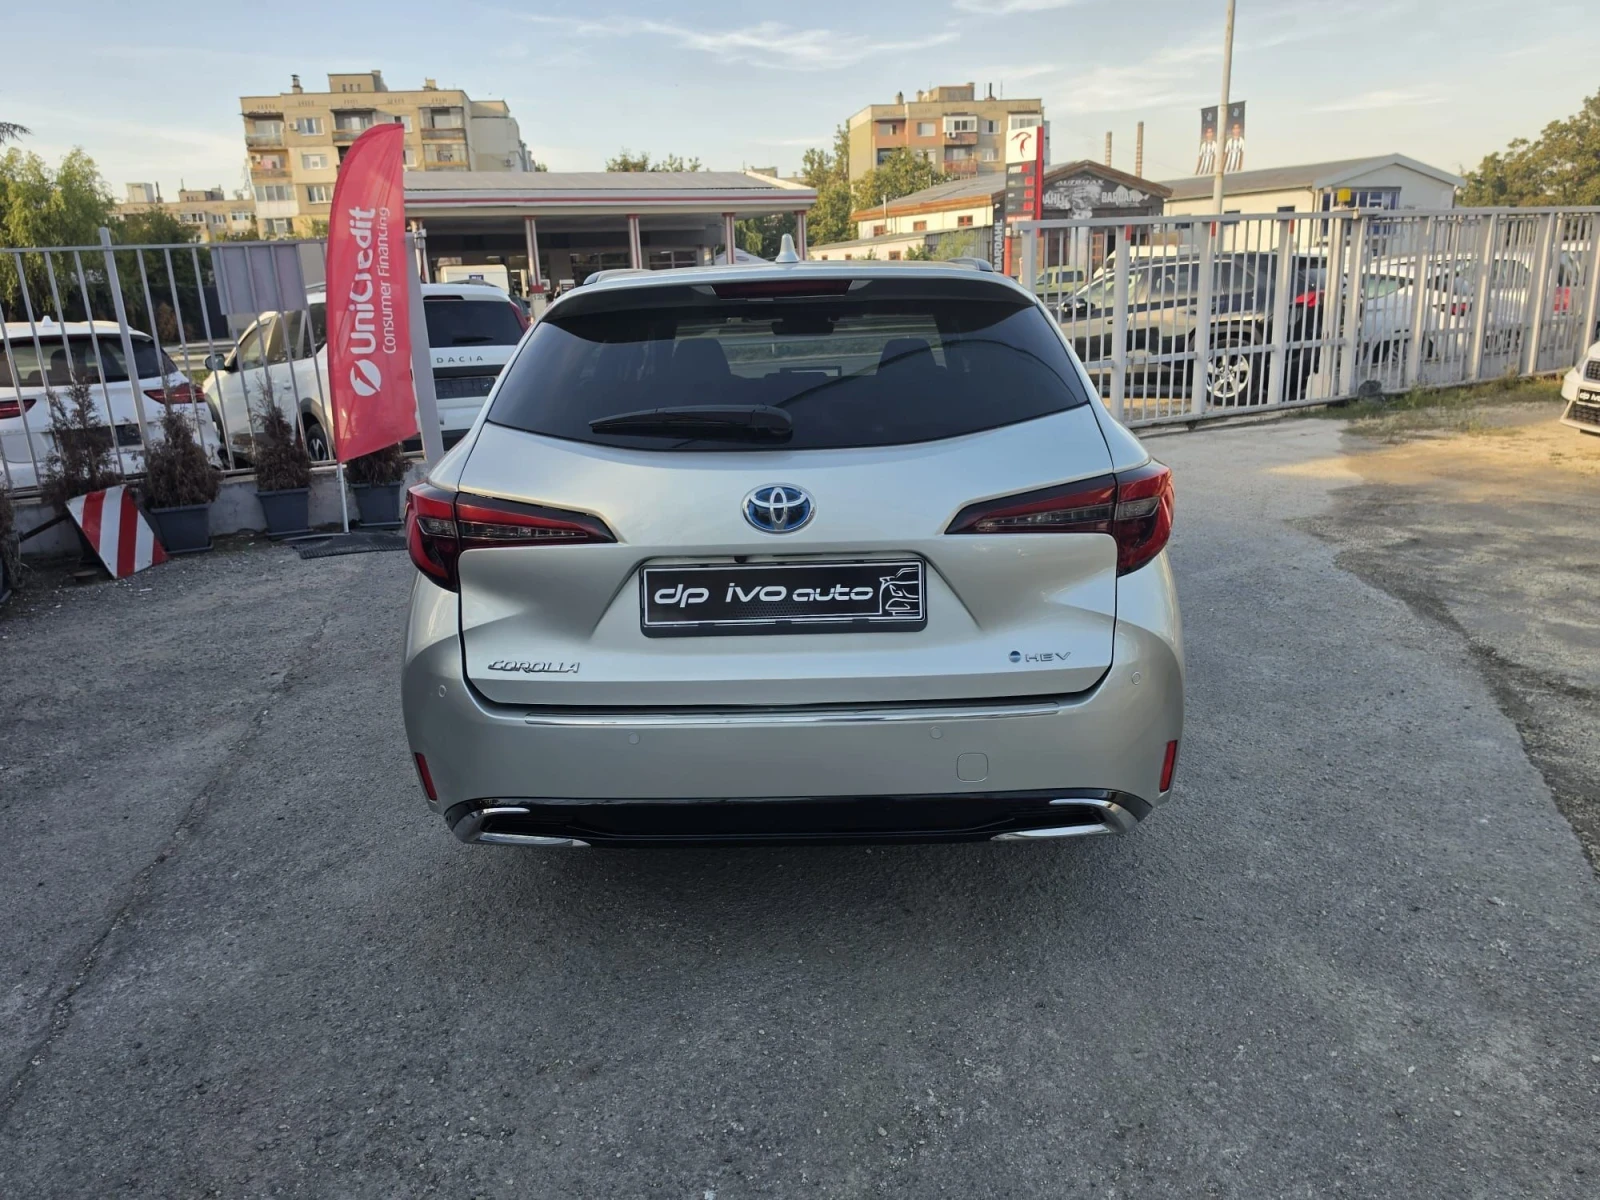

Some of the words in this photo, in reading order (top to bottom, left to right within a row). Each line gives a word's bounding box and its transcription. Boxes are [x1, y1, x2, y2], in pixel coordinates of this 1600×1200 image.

[377, 207, 391, 277] Financing
[994, 219, 1005, 272] BARDAHL
[349, 206, 376, 354] UniCredit
[379, 279, 397, 354] Consumer
[436, 355, 483, 364] DACIA
[654, 583, 710, 608] dp
[725, 583, 787, 603] ivo
[792, 584, 874, 602] auto
[487, 660, 580, 673] COROLLA
[1025, 652, 1071, 662] HEV
